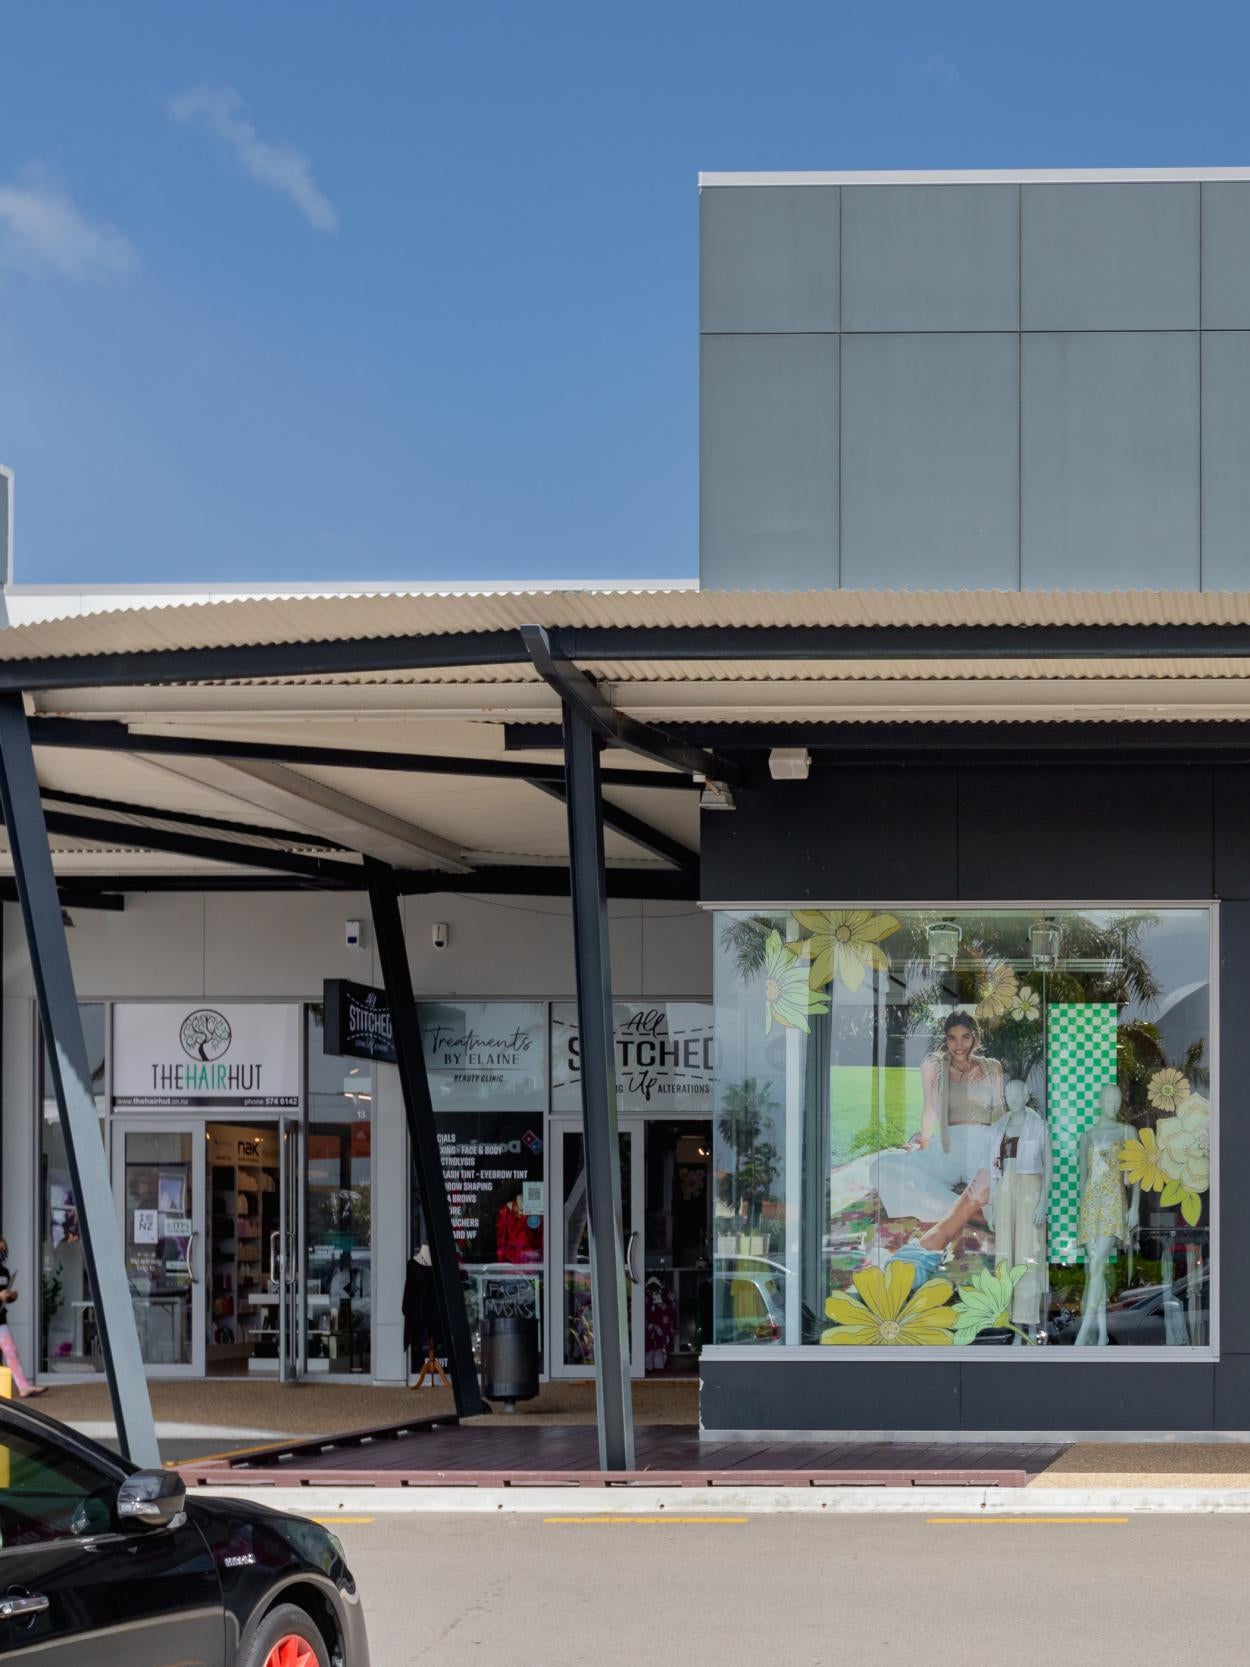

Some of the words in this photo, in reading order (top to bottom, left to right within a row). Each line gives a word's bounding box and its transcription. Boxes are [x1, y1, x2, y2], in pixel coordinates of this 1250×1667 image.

[349, 1004, 393, 1039] STITCHED
[620, 1009, 665, 1039] All
[424, 1026, 533, 1056] Treatments
[444, 1053, 462, 1065] BY
[469, 1053, 520, 1065] ELAINE
[568, 1036, 714, 1071] STCHED
[453, 1074, 479, 1083] BEAUTY
[480, 1074, 504, 1083] CLINIC
[629, 1070, 658, 1101] Up
[658, 1084, 711, 1094] ALTERATIONS
[244, 1097, 265, 1106] phone
[437, 1133, 456, 1143] CIALS
[440, 1145, 456, 1155] XING
[461, 1145, 477, 1155] FACE
[484, 1145, 502, 1155] BODY
[461, 1170, 475, 1179] TINT
[480, 1170, 512, 1179] EYEBROW
[513, 1170, 528, 1179] TINT
[463, 1182, 493, 1191] SHAPING
[489, 1283, 529, 1298] FACE
[485, 1299, 533, 1318] MASKS
